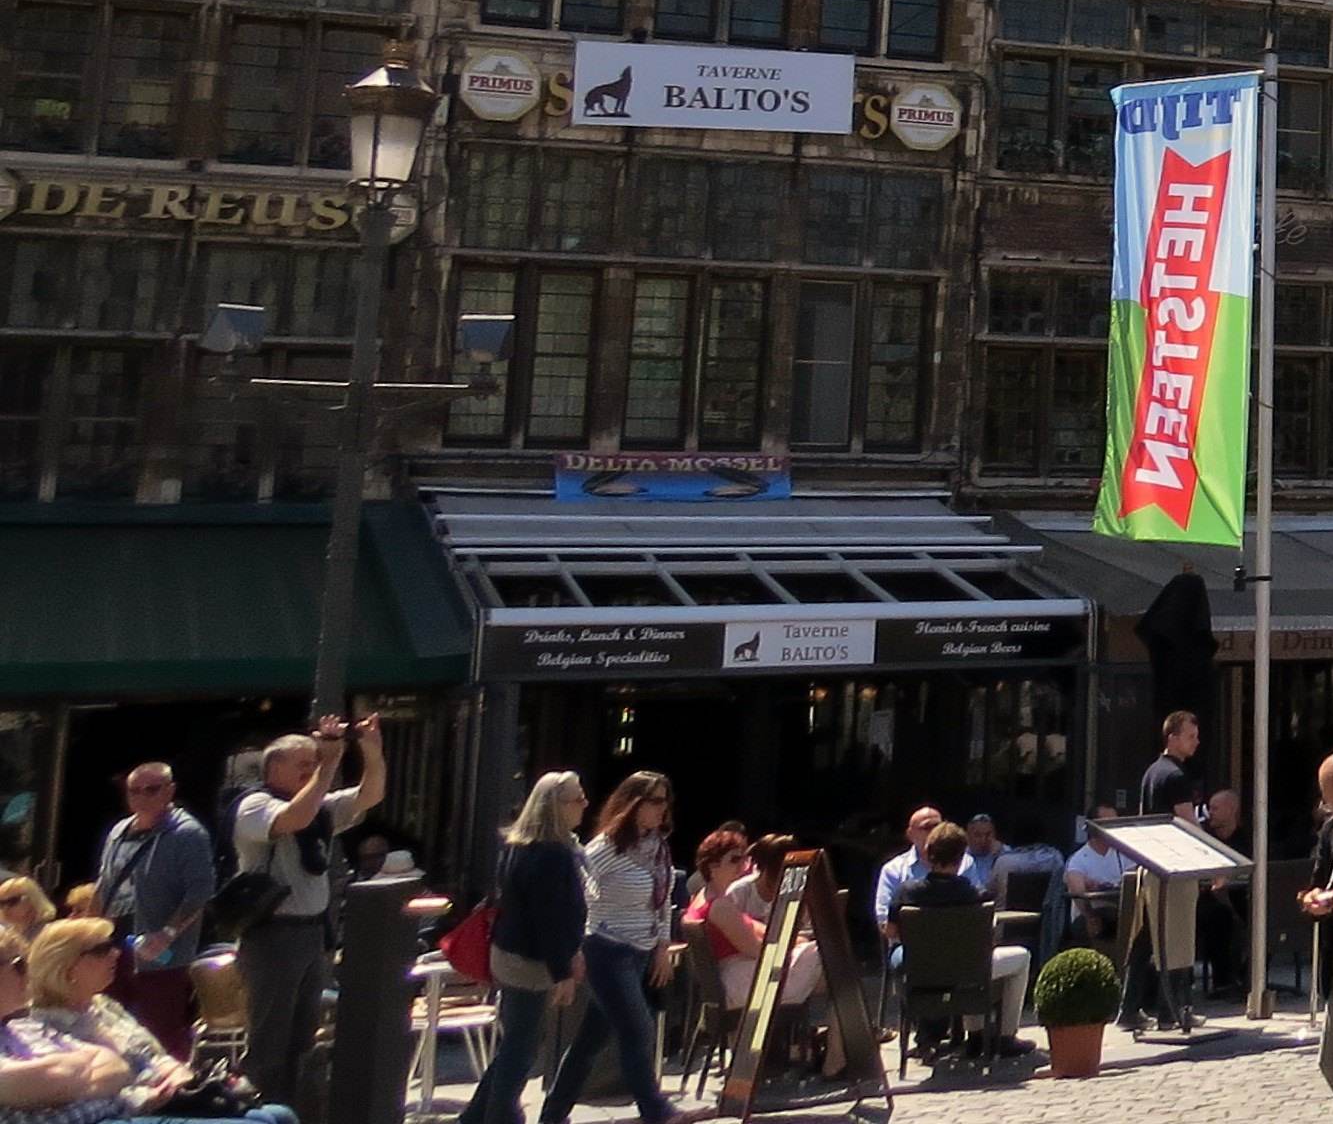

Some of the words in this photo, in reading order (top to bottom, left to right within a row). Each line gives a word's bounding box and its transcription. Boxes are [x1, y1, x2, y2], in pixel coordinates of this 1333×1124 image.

[696, 64, 782, 81] TAVERNE
[468, 75, 535, 92] PRIMUS
[663, 84, 811, 114] BALTO'S
[897, 107, 955, 123] PRIMUS
[22, 179, 129, 220] DE
[140, 182, 352, 231] REUS
[564, 453, 659, 472] DELTA
[578, 628, 620, 642] Lunch
[624, 628, 636, 641] &
[640, 627, 686, 640] Dinner
[782, 624, 850, 639] Taverne
[780, 646, 850, 662] BALTO'S
[941, 642, 988, 657] Belgian
[990, 641, 1023, 654] Beers
[537, 652, 592, 669] Belgian
